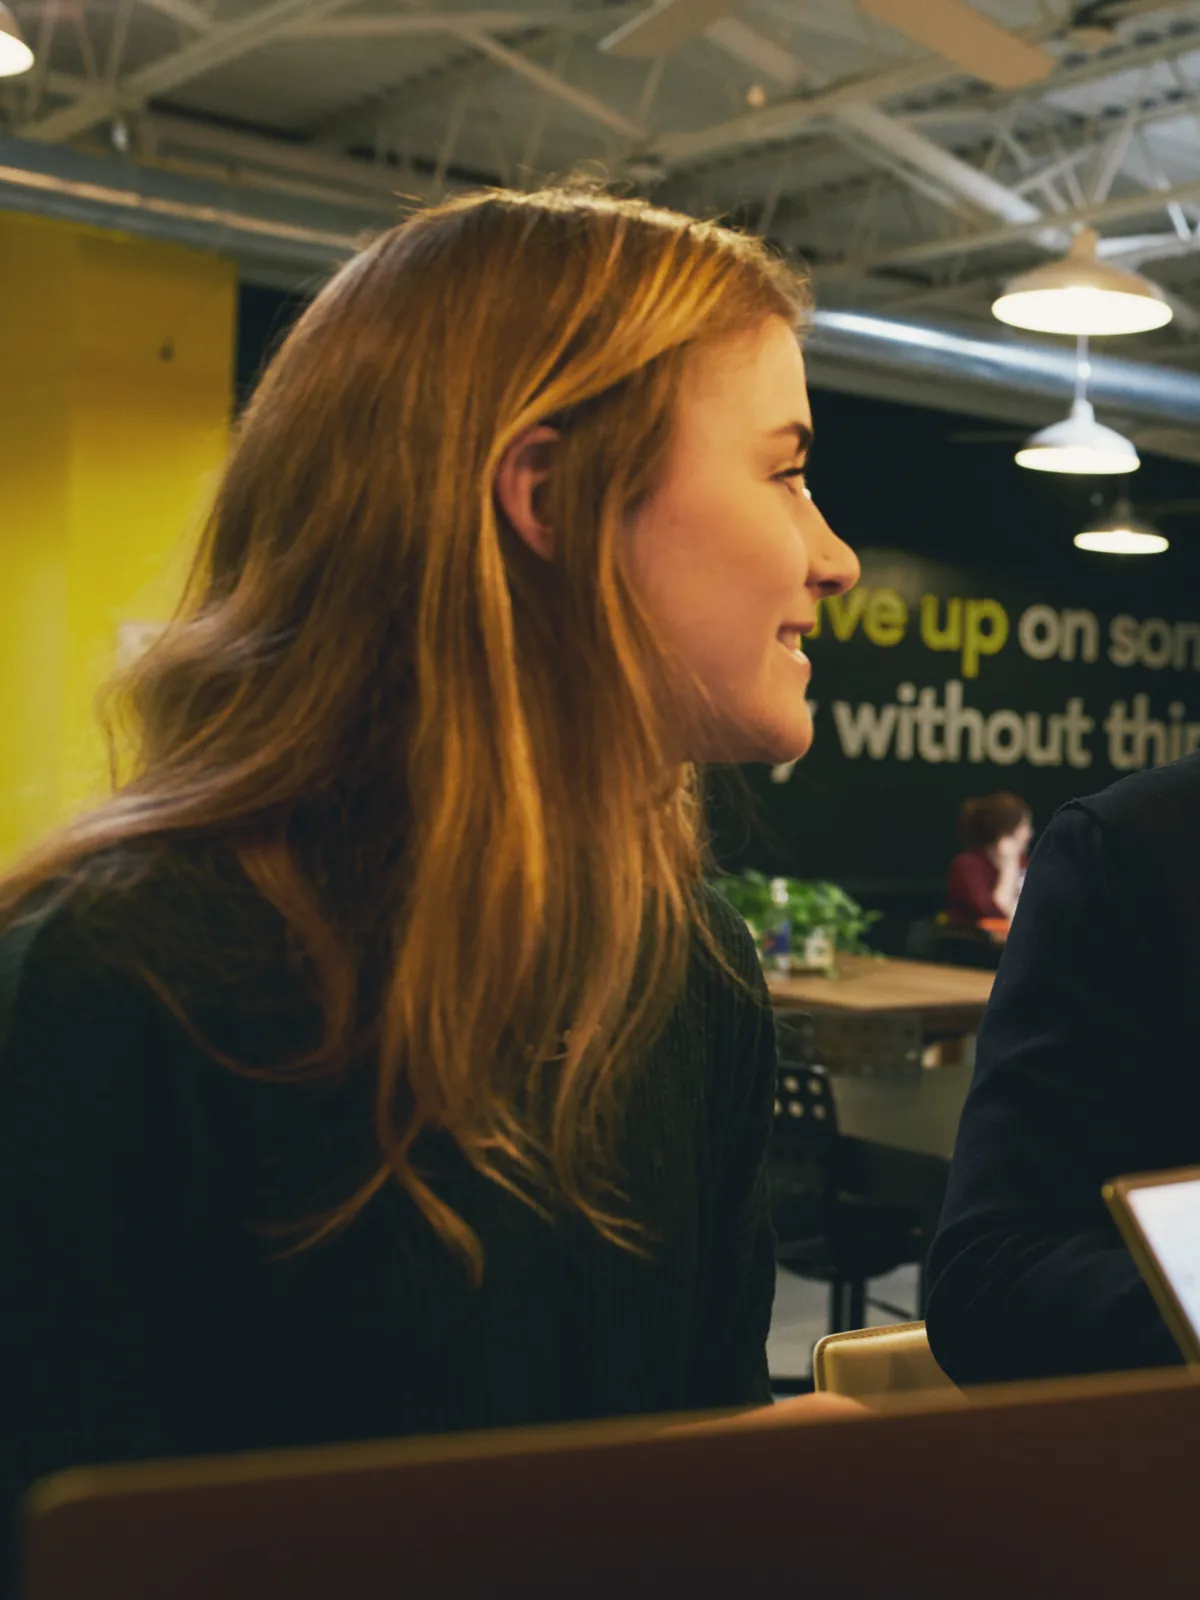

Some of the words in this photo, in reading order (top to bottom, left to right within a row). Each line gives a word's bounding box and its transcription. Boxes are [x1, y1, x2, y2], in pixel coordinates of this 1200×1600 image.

[921, 594, 1008, 678] up
[1018, 604, 1098, 664] on
[833, 681, 1094, 768] without
